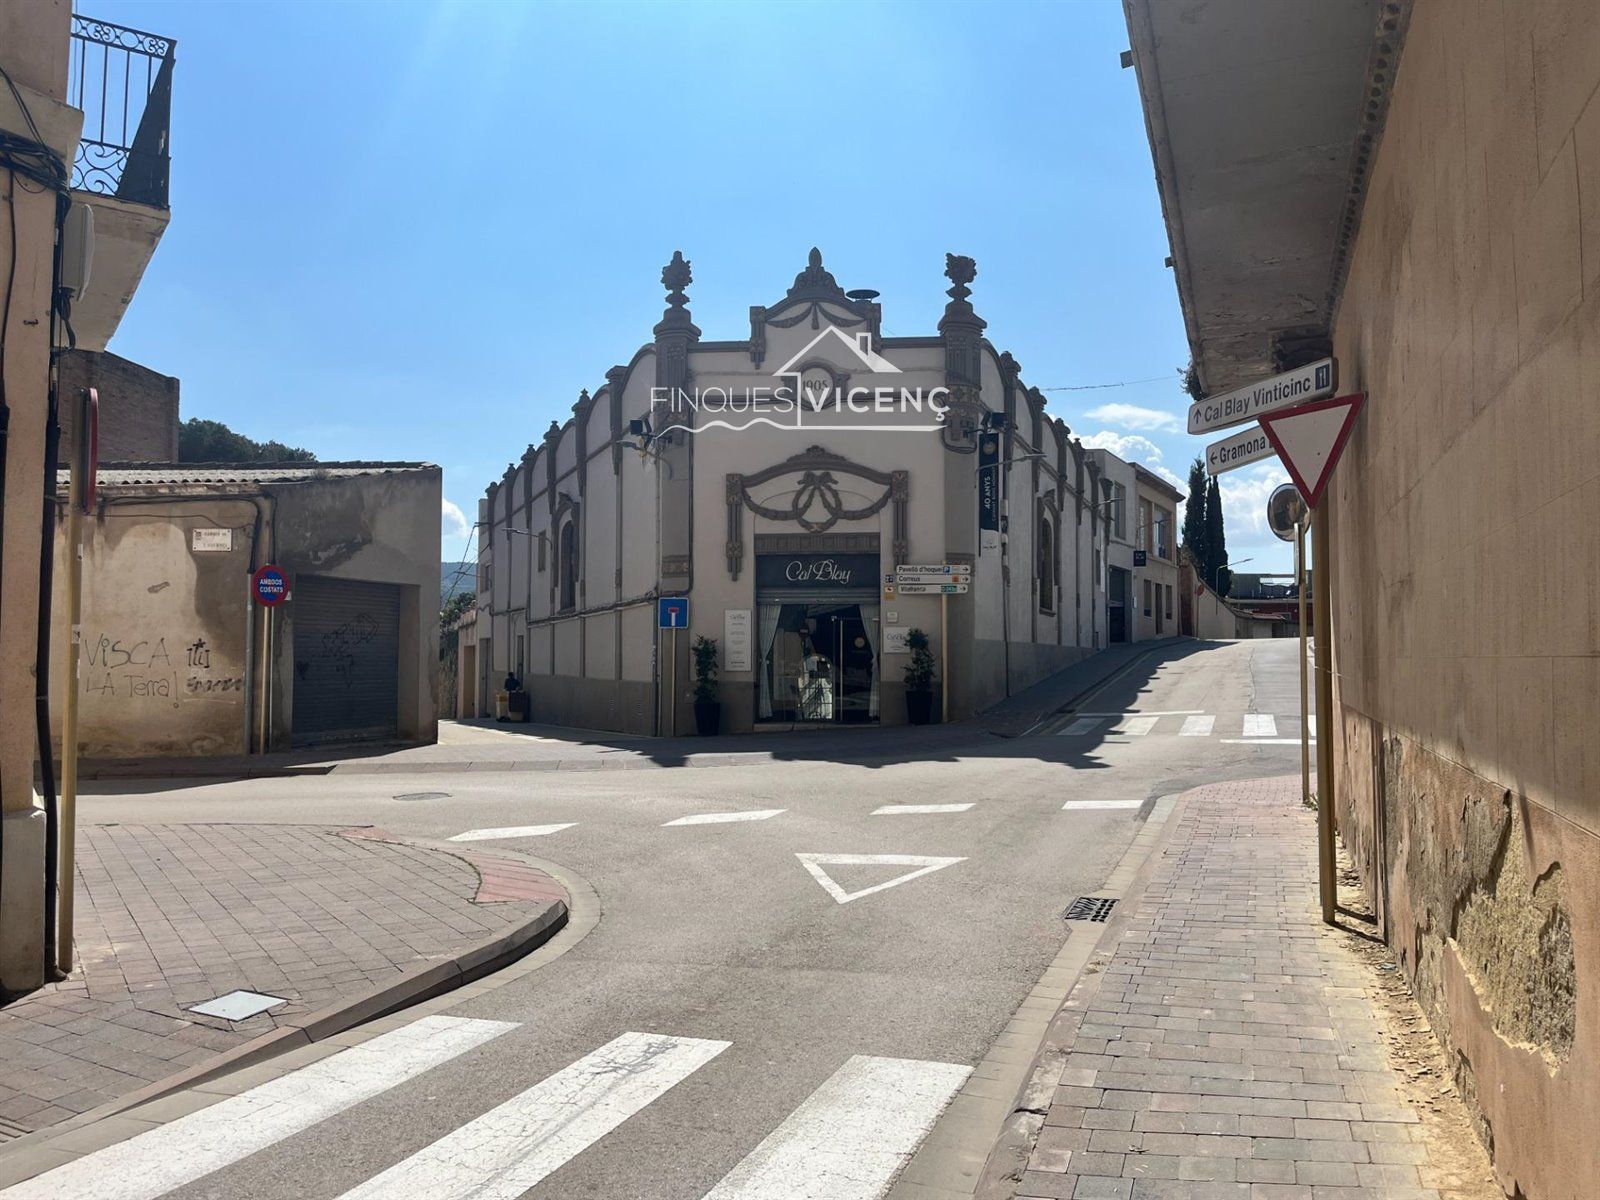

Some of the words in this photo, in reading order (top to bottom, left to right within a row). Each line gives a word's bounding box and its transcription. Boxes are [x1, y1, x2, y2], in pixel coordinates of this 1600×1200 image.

[1204, 402, 1223, 422] Cal
[1225, 396, 1251, 417] Blay
[1253, 377, 1311, 407] Vinticinc
[1219, 436, 1266, 463] Gramona
[984, 498, 991, 509] 40
[786, 560, 812, 581] Cal
[813, 559, 851, 584] Blay
[86, 672, 115, 696] LA
